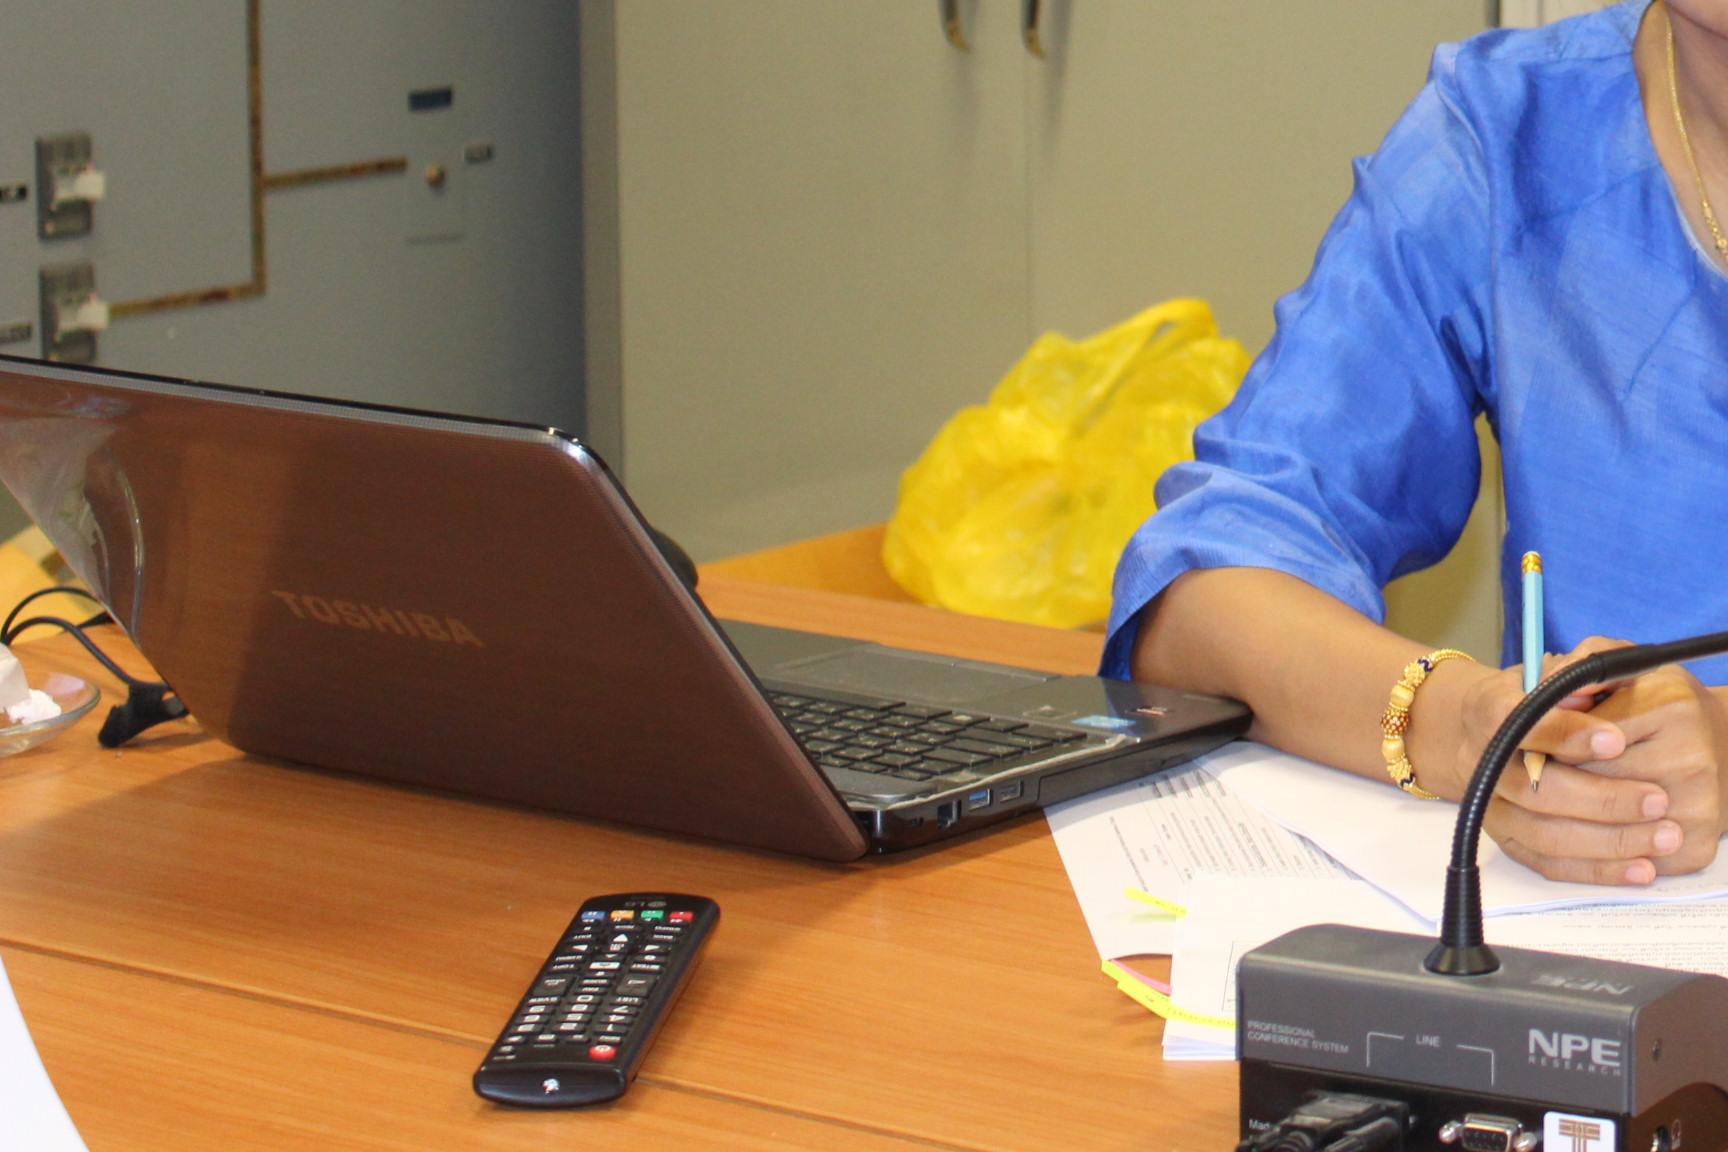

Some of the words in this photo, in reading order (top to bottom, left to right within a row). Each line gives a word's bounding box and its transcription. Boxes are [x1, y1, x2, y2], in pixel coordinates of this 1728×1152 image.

[271, 590, 486, 648] TOSHIBA
[608, 1014, 625, 1022] 4
[612, 1005, 629, 1013] 7
[1247, 1020, 1316, 1038] PROFESSIONAL
[1247, 1031, 1309, 1048] CONFERENCE
[1311, 1039, 1349, 1054] SYSTEM
[1416, 1034, 1441, 1047] LINE
[1528, 1028, 1621, 1067] NPE
[1528, 1055, 1621, 1076] RESEARCH
